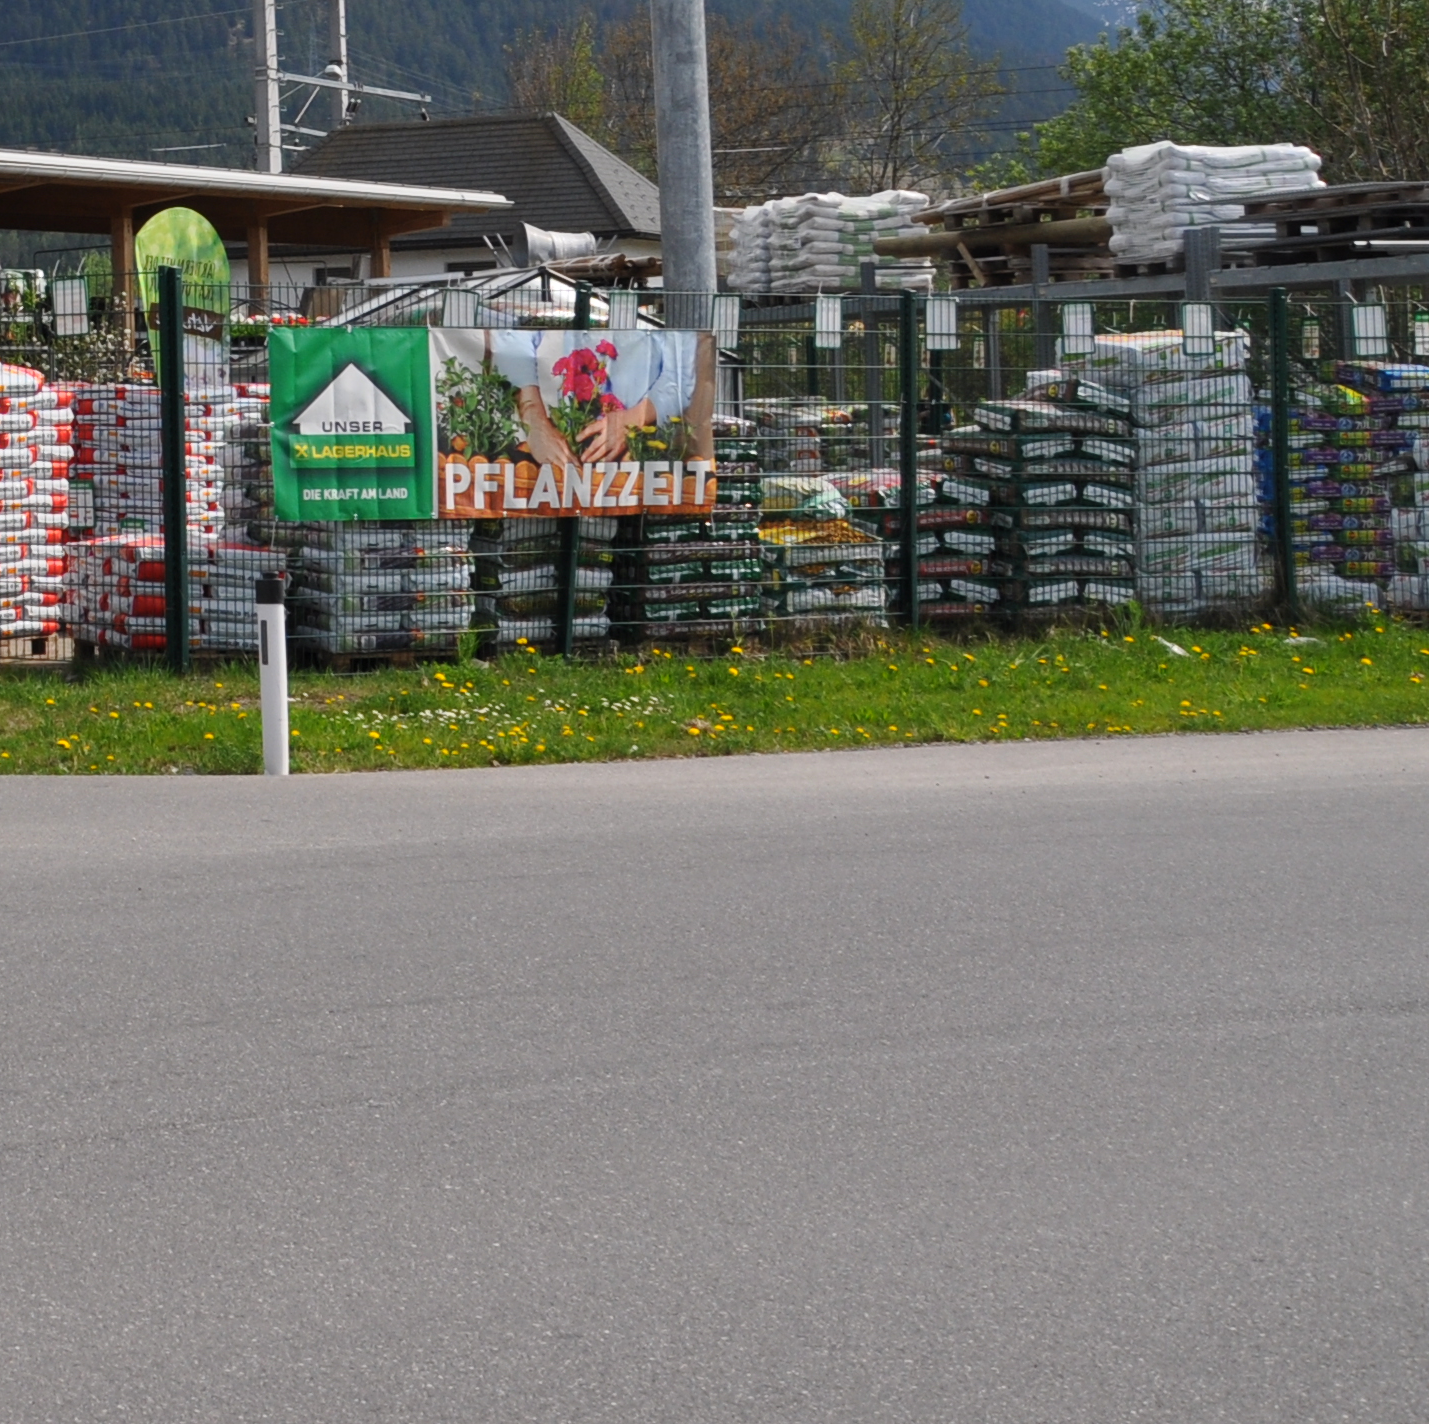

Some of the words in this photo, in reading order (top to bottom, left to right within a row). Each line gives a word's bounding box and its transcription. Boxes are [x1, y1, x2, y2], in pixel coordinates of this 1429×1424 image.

[322, 421, 383, 433] UNSER
[311, 444, 411, 458] LAGERHAUS
[445, 460, 711, 510] PFLANZZEIT
[303, 489, 322, 500] DIE
[324, 488, 359, 500] KRAFT
[361, 488, 376, 499] AM
[378, 488, 408, 499] LAND
